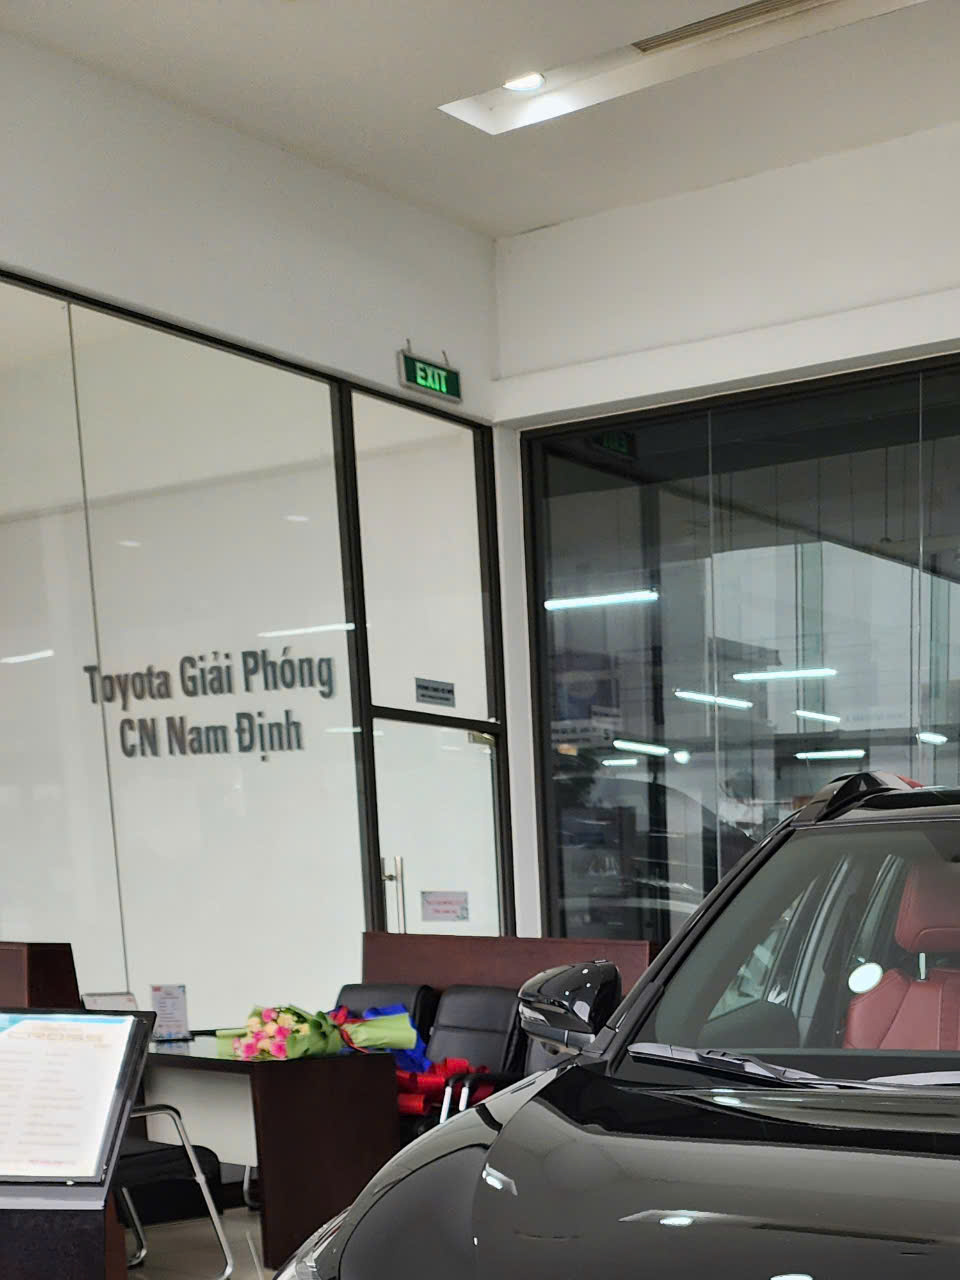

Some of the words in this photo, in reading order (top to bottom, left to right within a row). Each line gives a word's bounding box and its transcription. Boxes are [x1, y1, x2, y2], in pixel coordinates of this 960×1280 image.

[415, 361, 447, 393] EXIT
[83, 664, 172, 711] Toyota
[180, 651, 234, 697] Giải
[241, 646, 334, 699] Phóng
[120, 717, 160, 758] CN
[166, 716, 229, 756] Nam
[235, 709, 304, 762] Định
